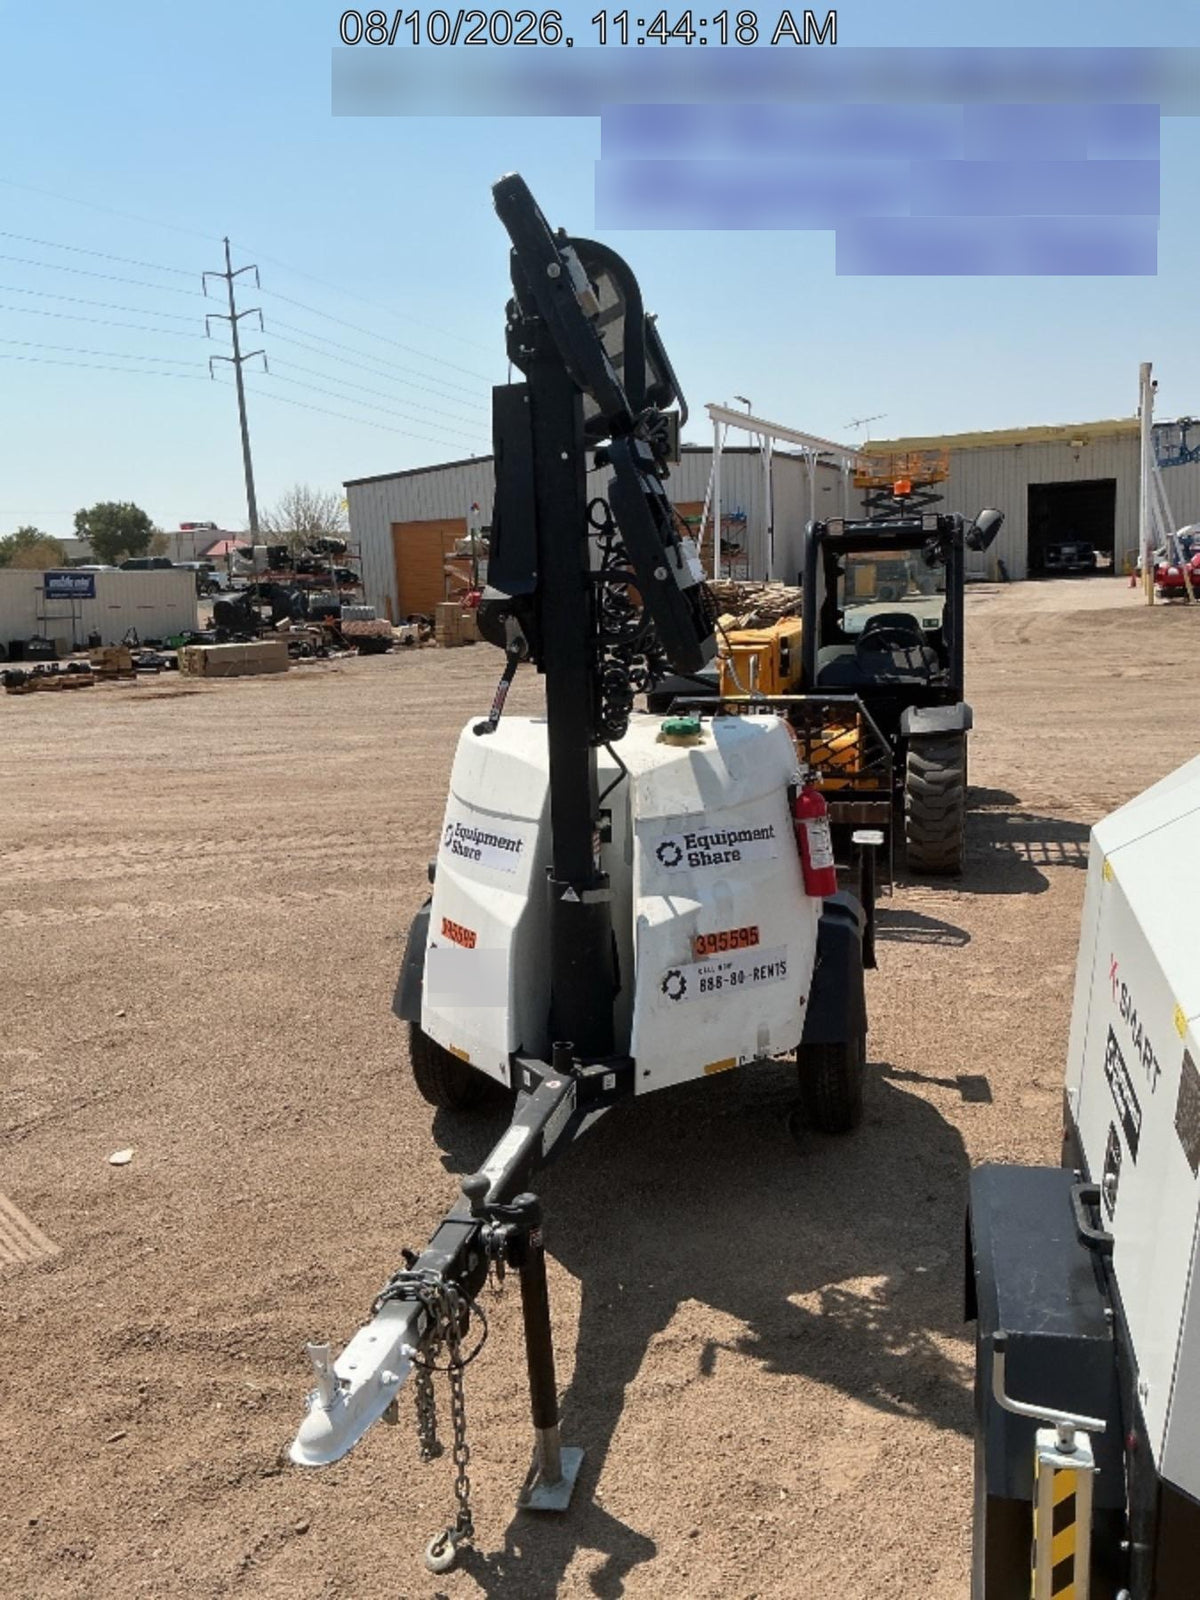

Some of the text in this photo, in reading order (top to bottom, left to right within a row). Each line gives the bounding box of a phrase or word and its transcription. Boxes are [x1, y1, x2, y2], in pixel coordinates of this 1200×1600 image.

[451, 839, 482, 861] Share
[455, 822, 523, 853] Equipment
[683, 824, 776, 851] Equipment
[688, 849, 741, 868] Share
[696, 926, 759, 955] 395595
